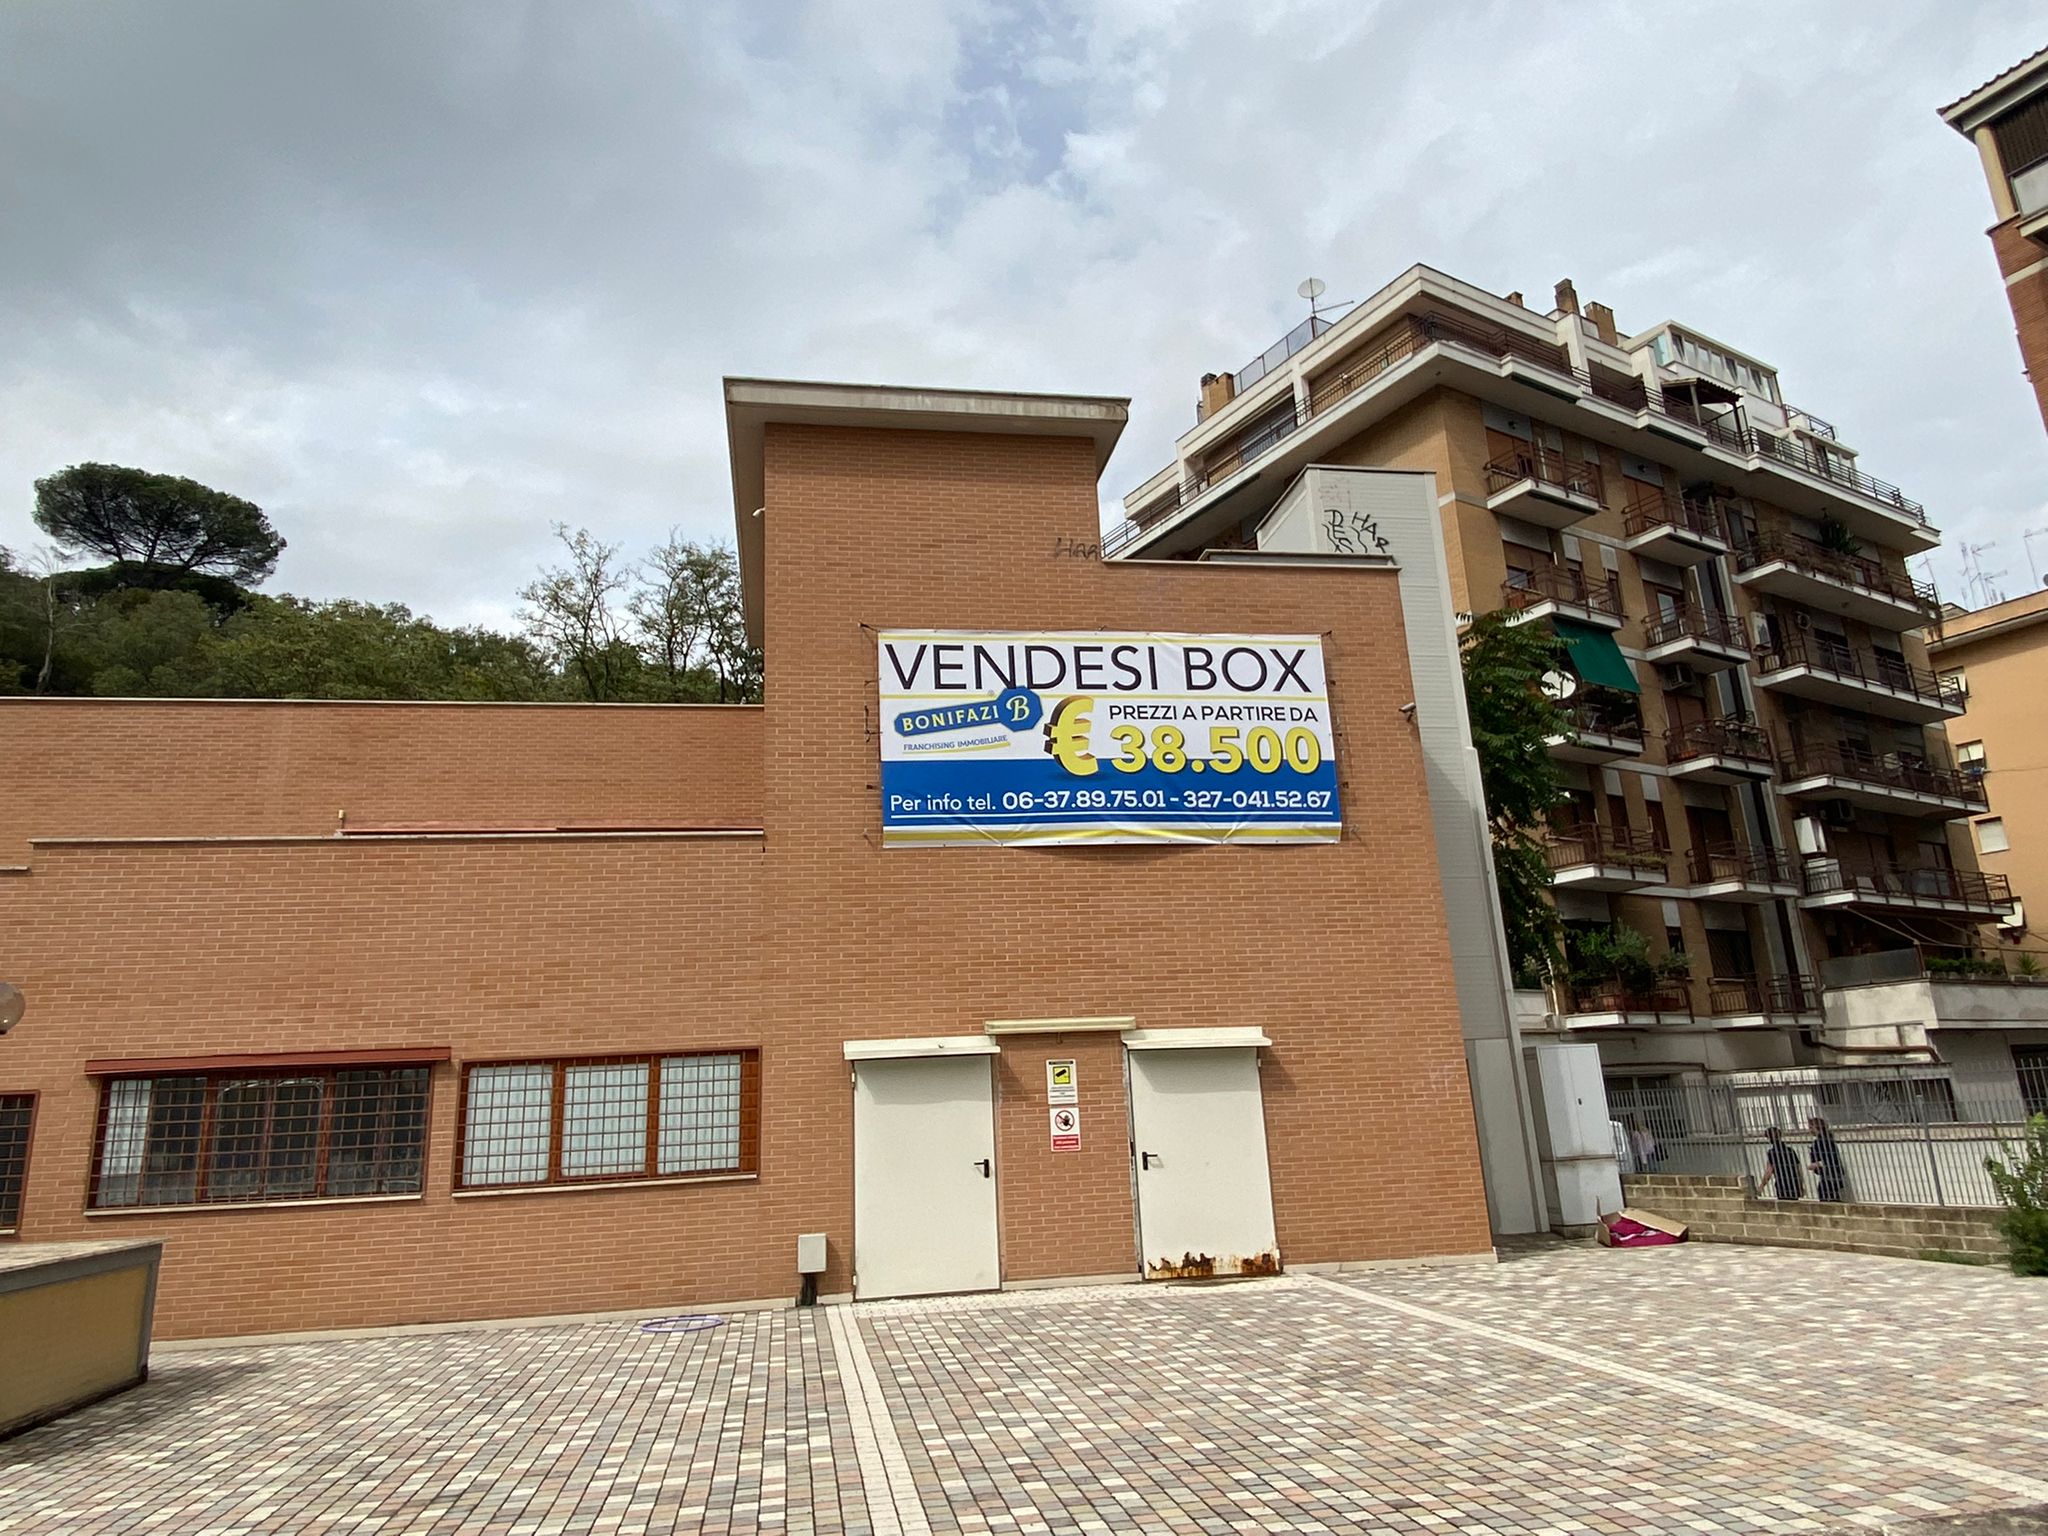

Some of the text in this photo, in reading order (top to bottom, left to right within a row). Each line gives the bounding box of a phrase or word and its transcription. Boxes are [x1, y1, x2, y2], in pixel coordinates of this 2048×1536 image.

[884, 643, 1312, 693] VENDESI BOX
[902, 695, 1030, 732] BONIFAZI B
[1109, 705, 1318, 722] PREZZI A PARTIRE DA
[903, 734, 1008, 751] FRANCHISING IMMOBILIARE
[1110, 725, 1322, 775] 38.500
[890, 795, 922, 811] Per
[927, 793, 962, 811] info
[967, 793, 996, 811] tel.
[1002, 790, 1166, 810] 06-37.89.75.01
[1183, 790, 1331, 808] 327-041.52.67
